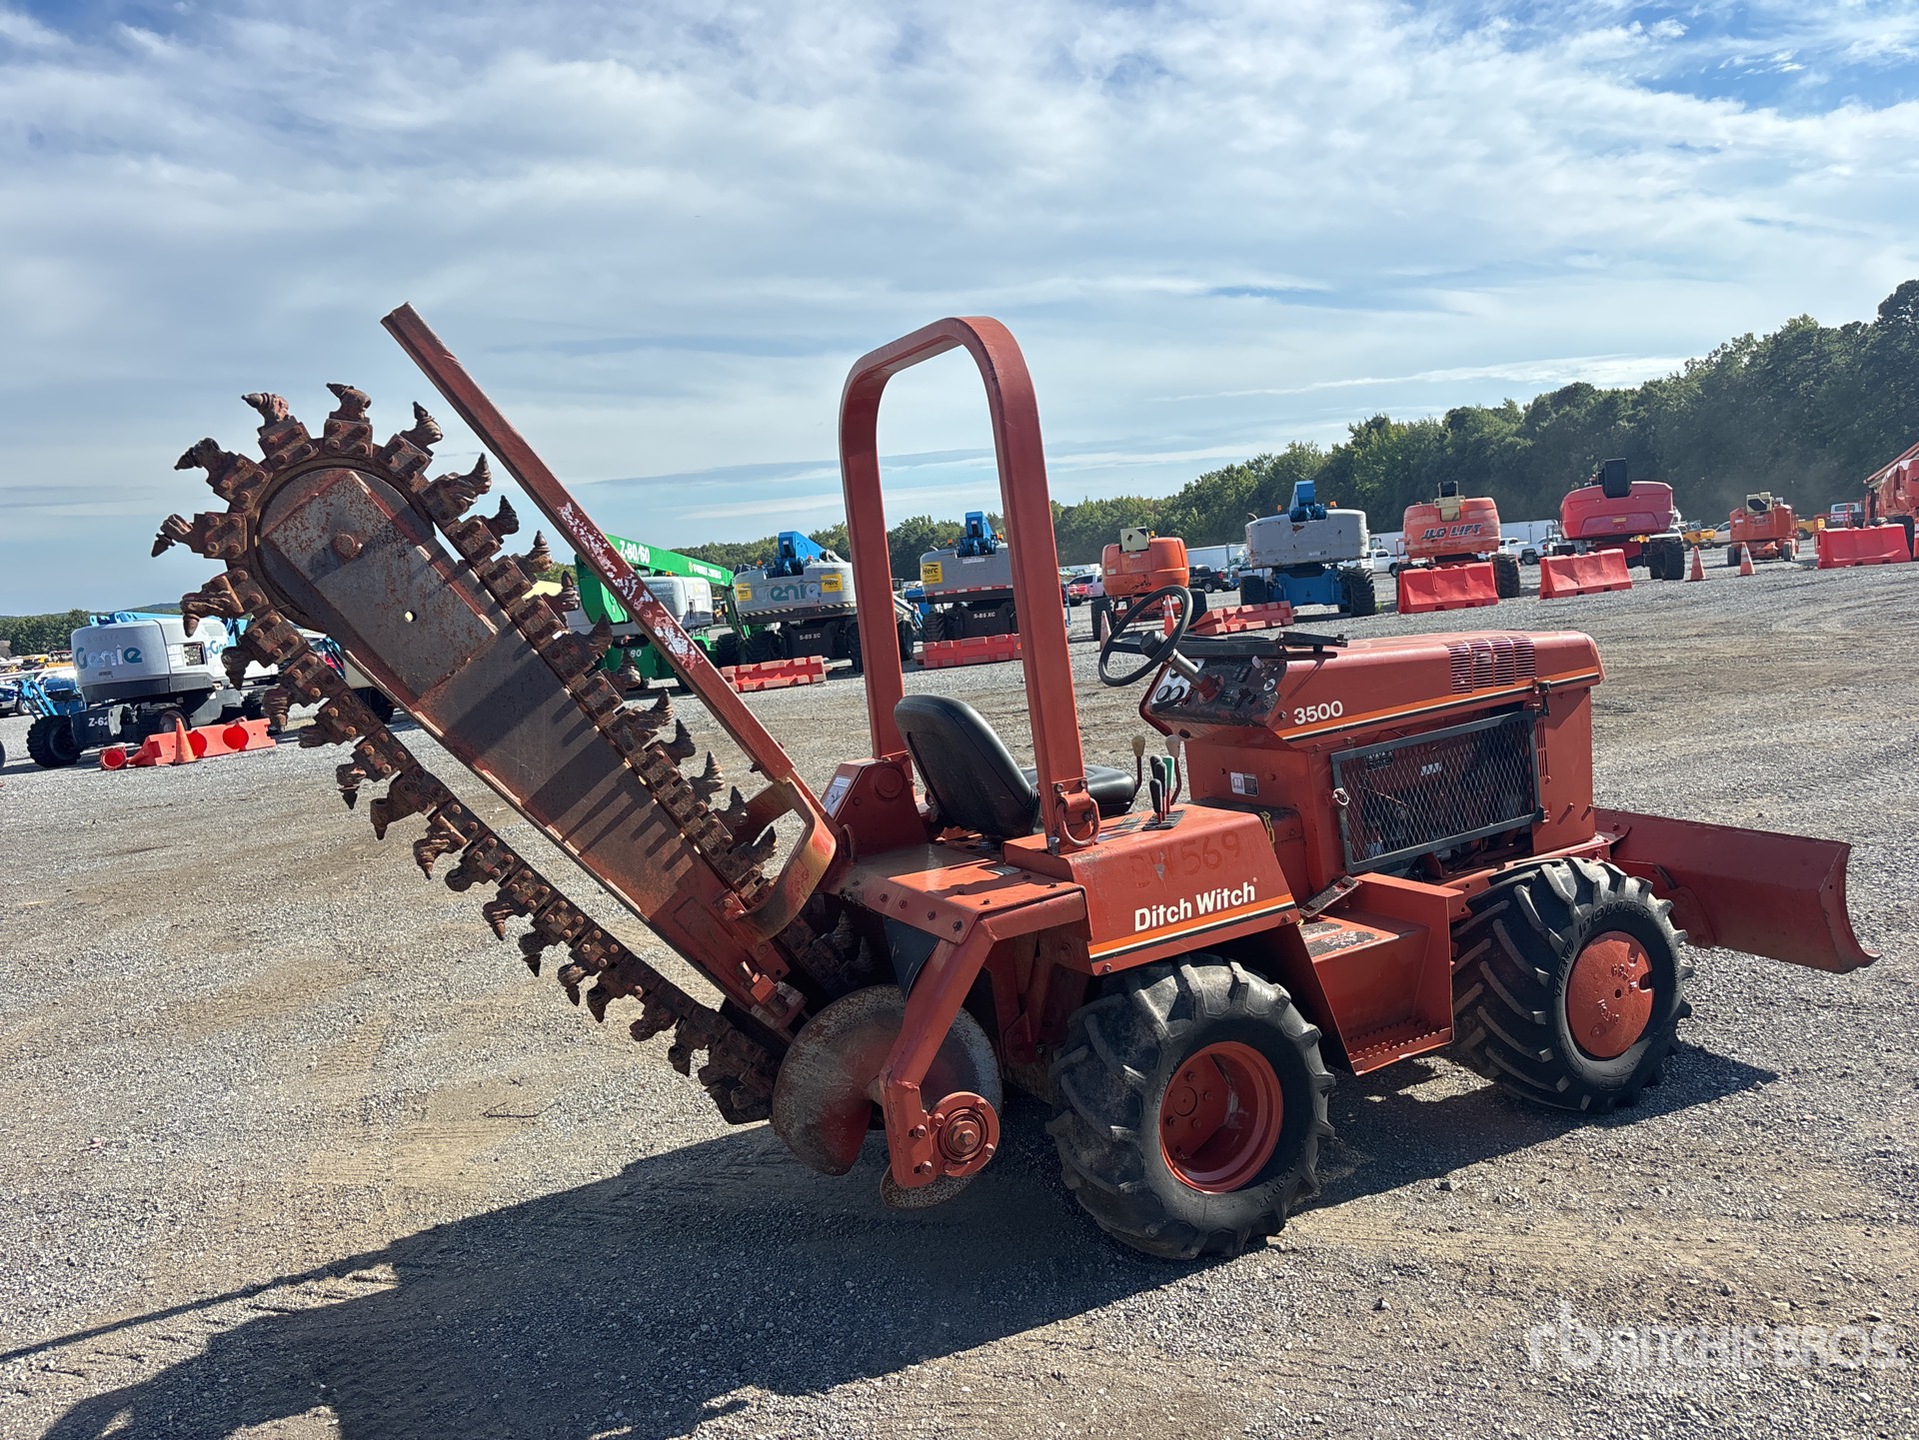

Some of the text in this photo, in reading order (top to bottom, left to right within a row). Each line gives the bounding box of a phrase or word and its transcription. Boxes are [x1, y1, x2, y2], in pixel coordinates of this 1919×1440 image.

[1421, 524, 1482, 540] JLG LIFT
[923, 567, 939, 575] Herc
[75, 644, 142, 669] Genie
[1293, 700, 1343, 725] 3500
[1134, 881, 1256, 932] Ditch Witch
